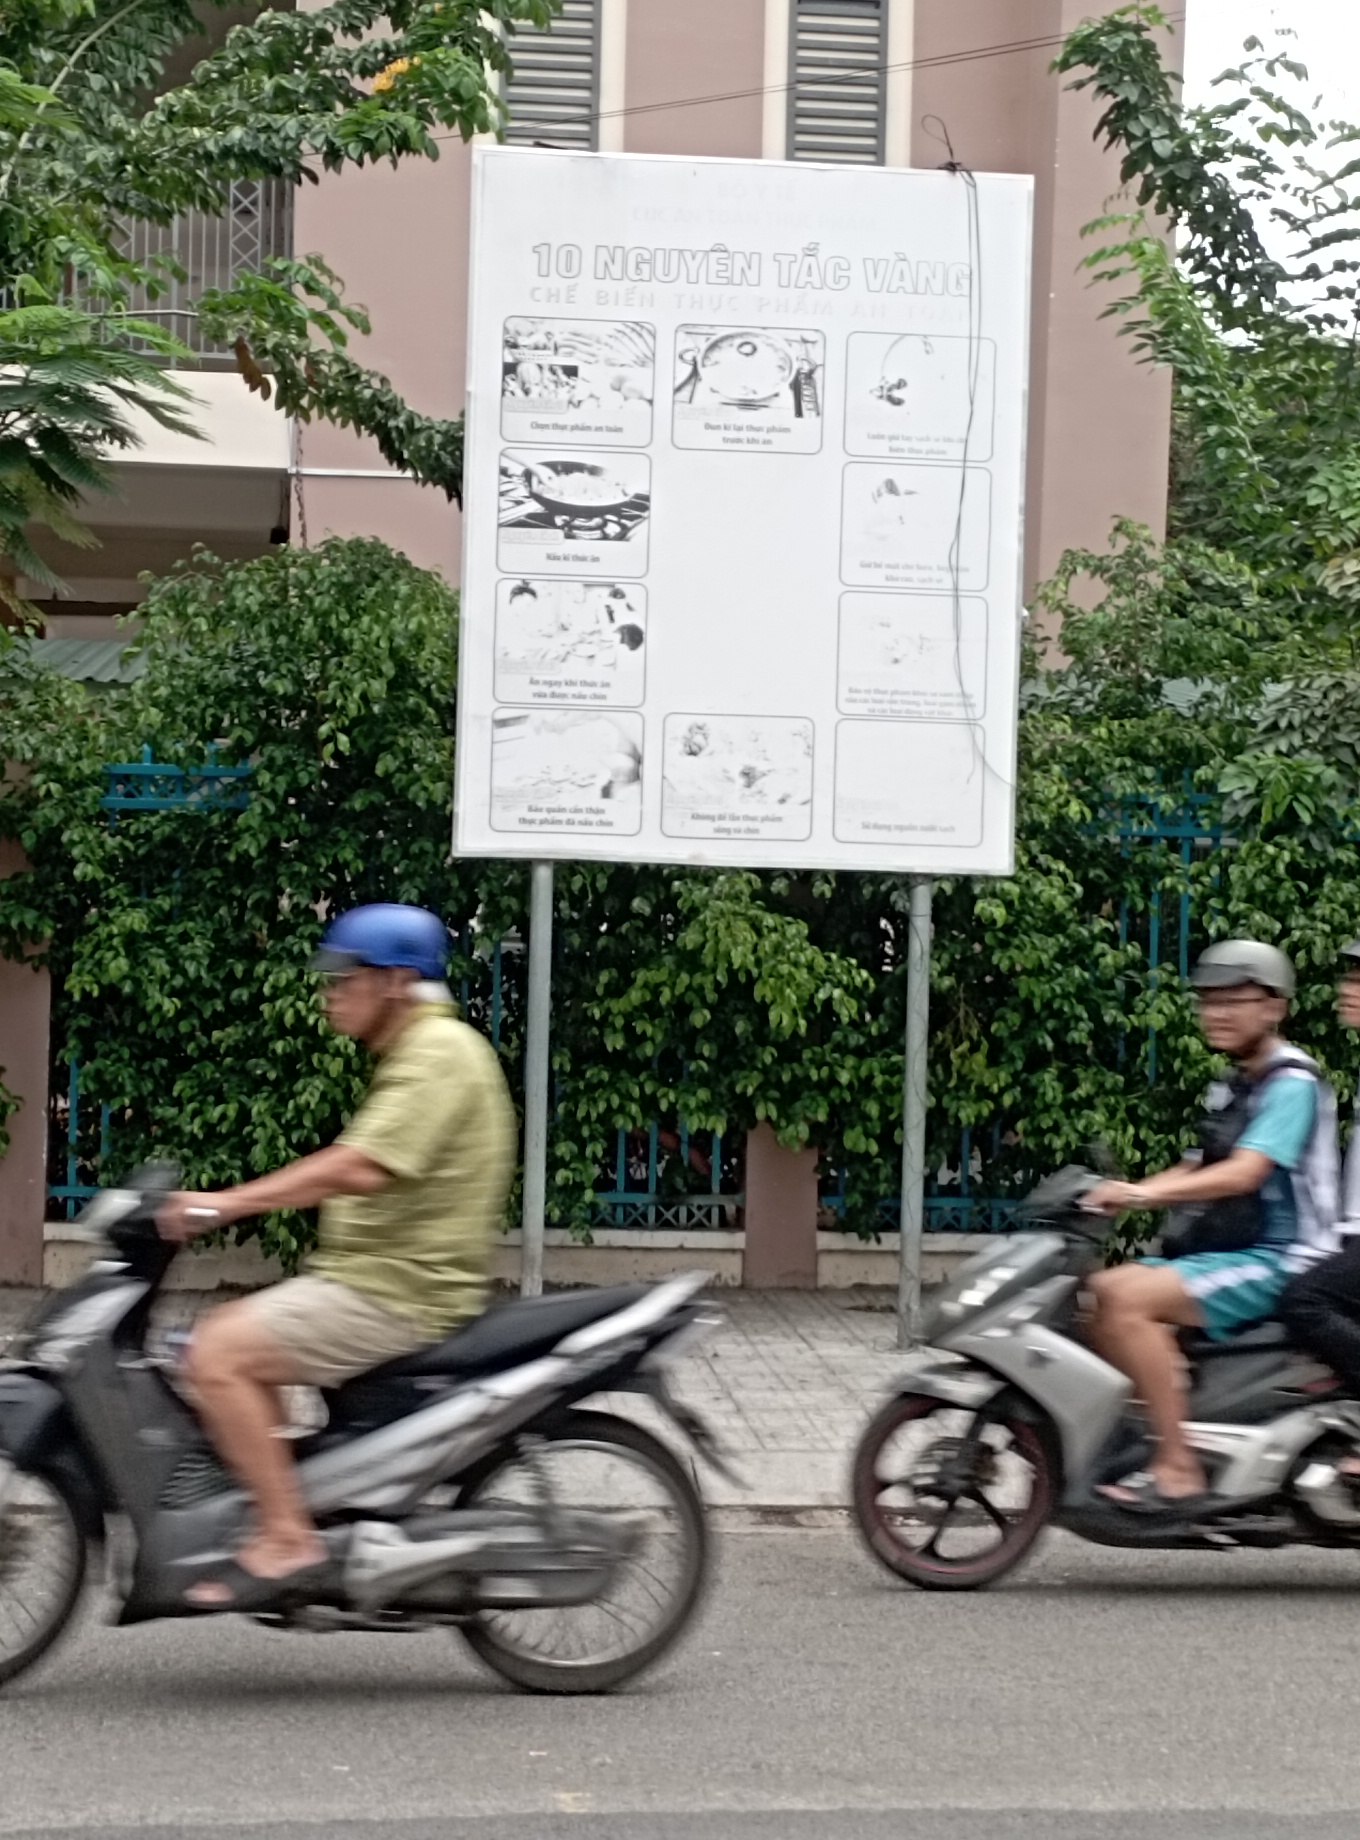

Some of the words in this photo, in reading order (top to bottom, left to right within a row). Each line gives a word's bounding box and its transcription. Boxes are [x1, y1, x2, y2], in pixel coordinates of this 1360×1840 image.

[533, 243, 582, 279] 10
[594, 243, 761, 287] NGUYÊN
[773, 242, 851, 291] TẮC
[862, 252, 972, 297] VÀNG
[529, 282, 579, 304] CHẾ
[596, 285, 655, 308] BIẾN
